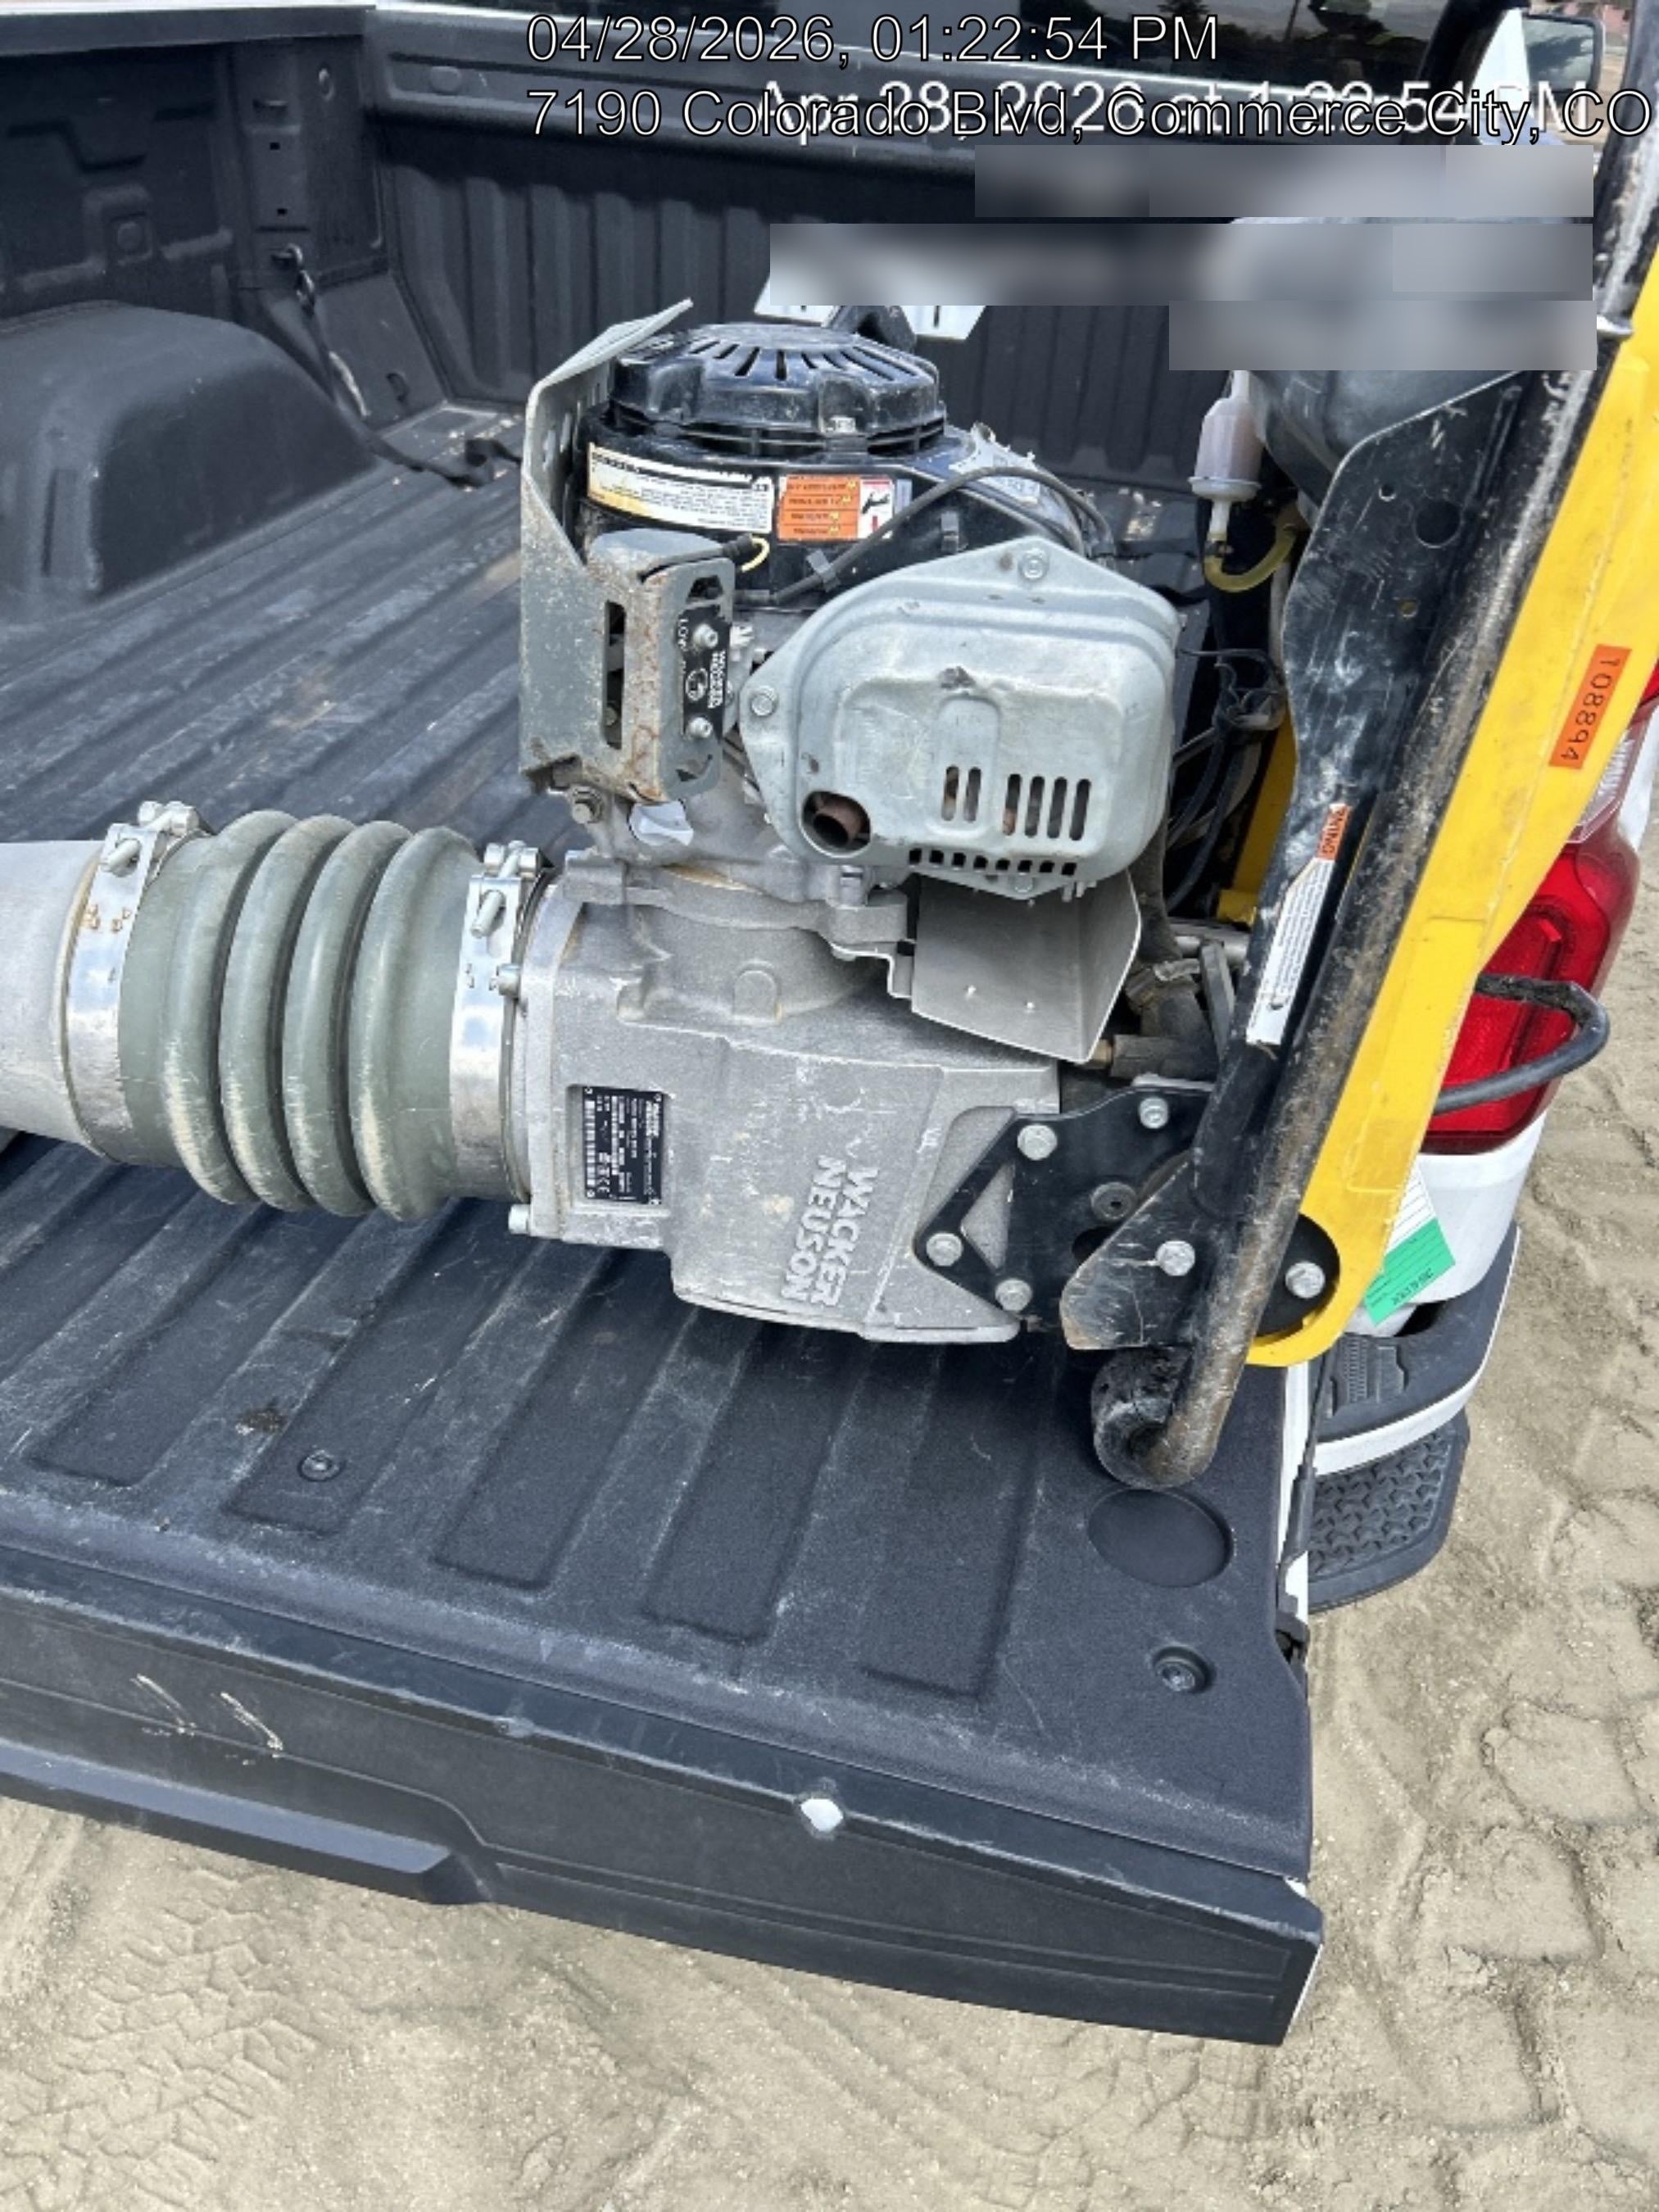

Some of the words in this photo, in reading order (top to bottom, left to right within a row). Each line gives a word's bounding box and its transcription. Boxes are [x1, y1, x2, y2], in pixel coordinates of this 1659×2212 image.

[1561, 659, 1620, 760] 108894
[782, 1155, 847, 1301] NEUSON
[811, 1167, 879, 1306] WACKER
